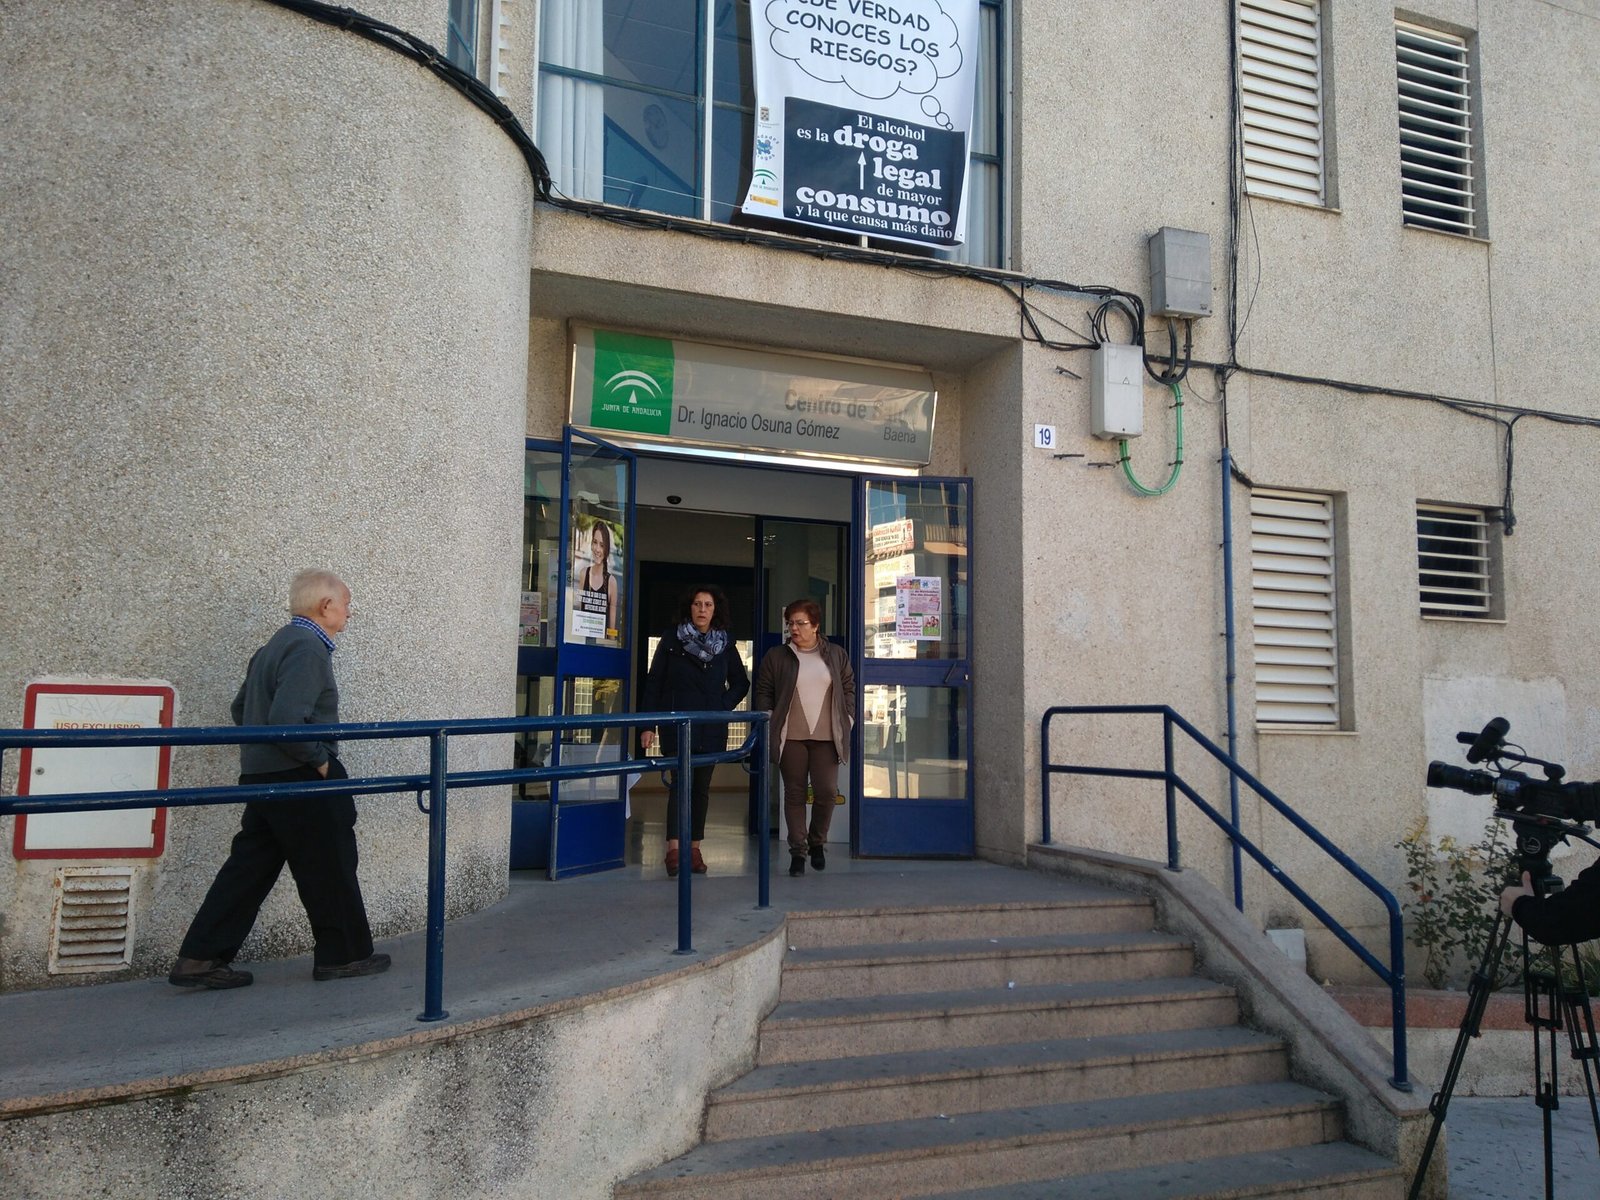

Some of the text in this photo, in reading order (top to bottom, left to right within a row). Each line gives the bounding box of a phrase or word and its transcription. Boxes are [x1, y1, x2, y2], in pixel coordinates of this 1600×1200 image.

[848, 0, 930, 32] VERDAD
[786, 10, 940, 58] CONOCES LOS
[810, 38, 918, 76] RIESGOS?
[796, 128, 812, 140] es
[816, 127, 830, 143] la
[833, 125, 919, 161] droga
[857, 114, 926, 142] El alcohol
[873, 157, 942, 190] legal
[796, 186, 951, 227] consumo
[877, 183, 942, 207] de mayor
[796, 203, 953, 240] y la que causa más daño
[601, 403, 621, 412] JUNTA
[622, 405, 630, 413] DE
[784, 388, 841, 417] Centro
[846, 401, 867, 421] de
[677, 405, 840, 440] Dr. Ignacio Osuna Gómez
[883, 426, 917, 444] Baena
[1039, 428, 1051, 445] 19
